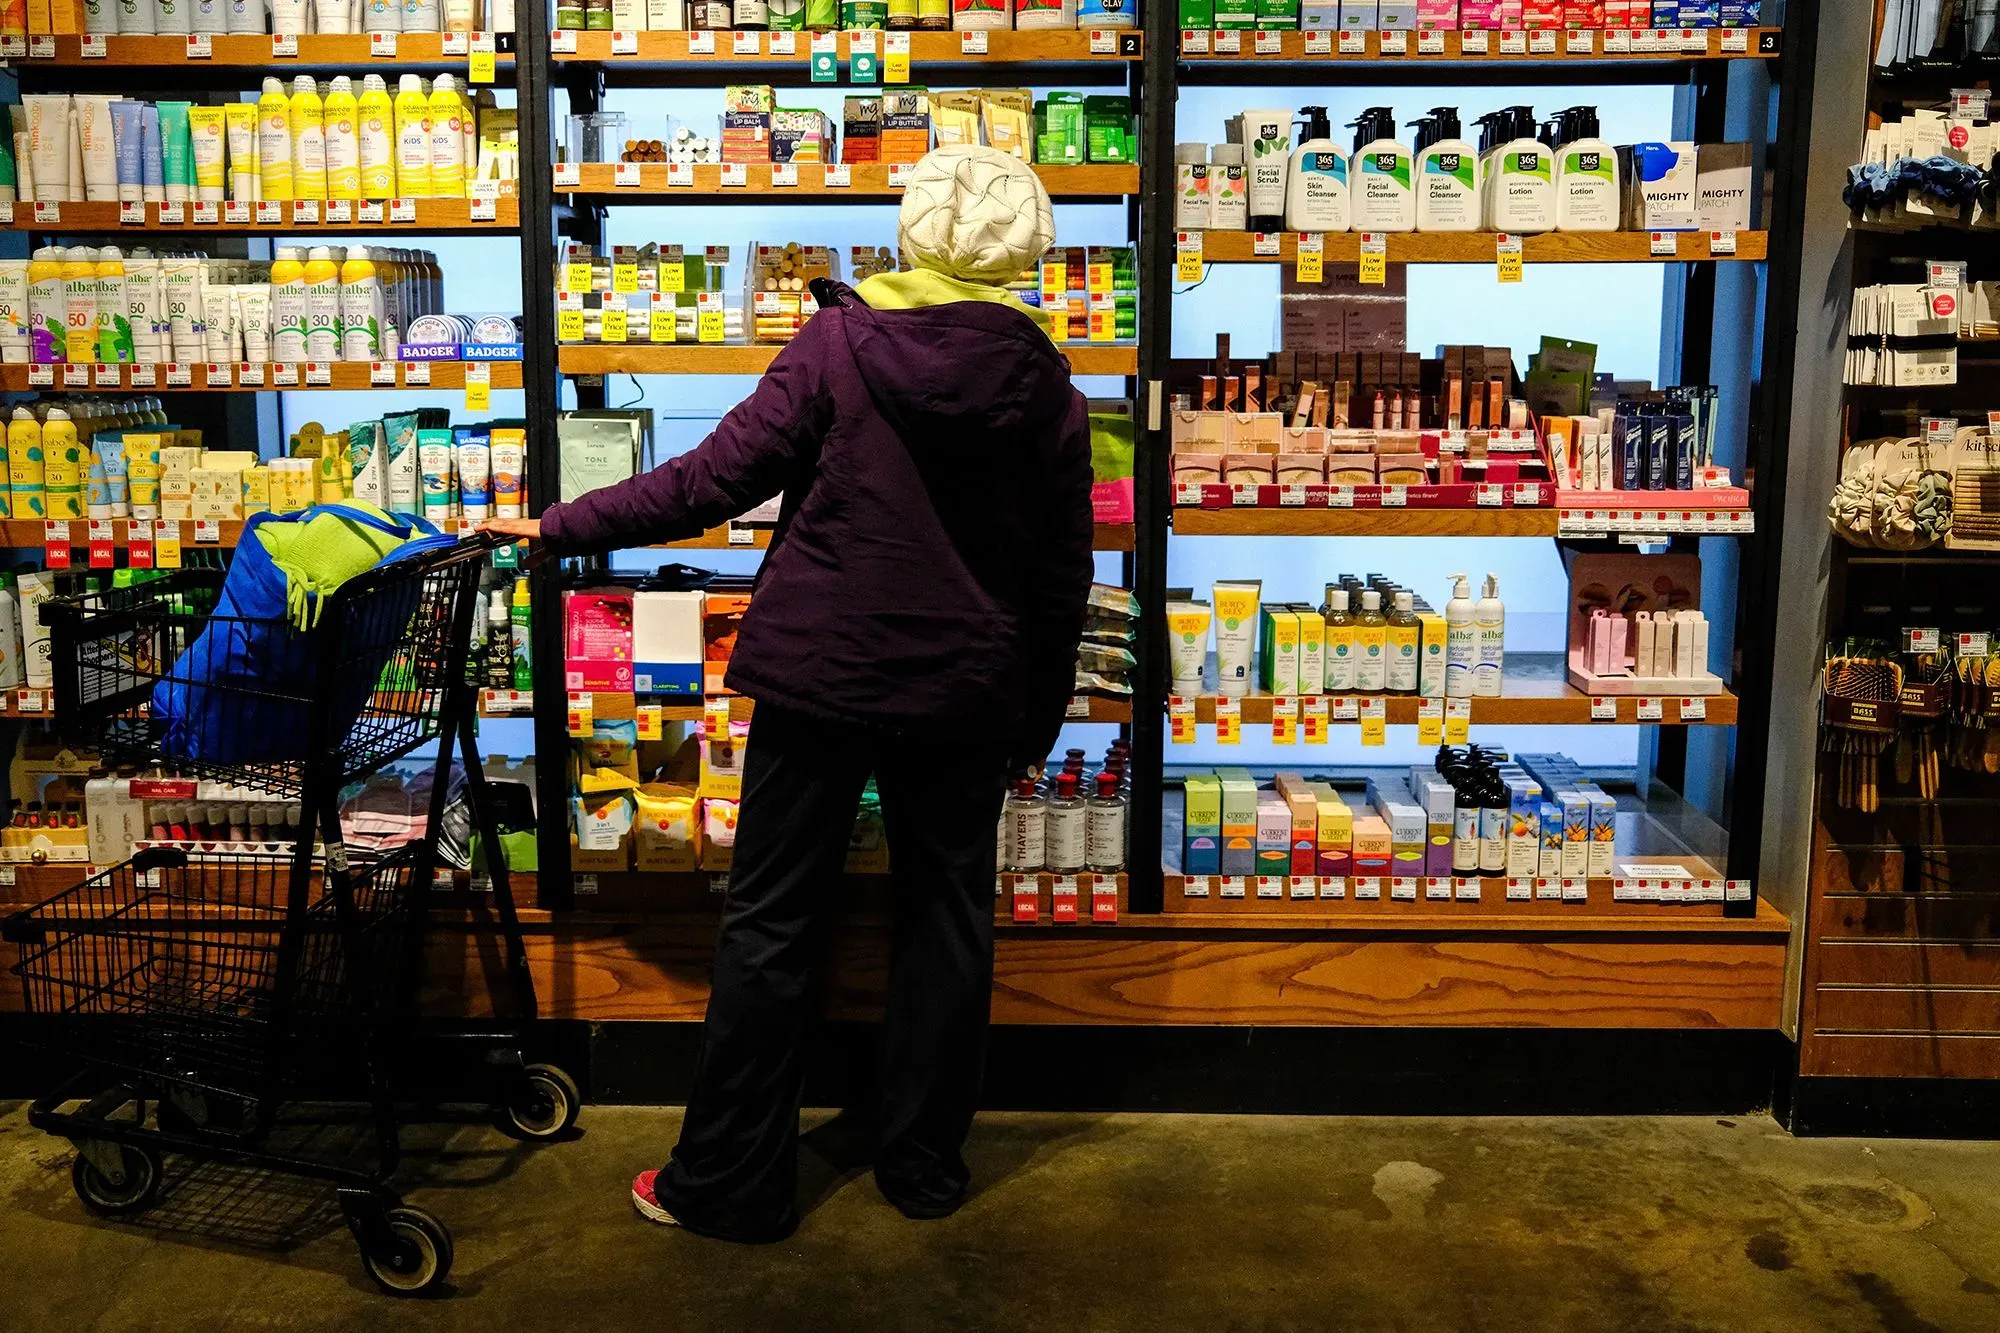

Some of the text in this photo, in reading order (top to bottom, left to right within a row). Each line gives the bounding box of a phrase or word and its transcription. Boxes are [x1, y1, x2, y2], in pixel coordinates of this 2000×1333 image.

[501, 37, 508, 48] 1
[1126, 40, 1135, 51] 2
[1263, 127, 1277, 135] 365
[1317, 155, 1334, 164] 365
[1378, 155, 1395, 165] 365
[1441, 155, 1458, 165] 365
[1519, 155, 1536, 165] 365
[1580, 155, 1597, 165] 365
[1193, 167, 1206, 175] 365
[1228, 167, 1241, 175] 365
[1257, 169, 1280, 177] Facial
[1257, 176, 1280, 184] Scrub
[500, 185, 513, 194] 20
[1509, 187, 1533, 195] Lotion
[1570, 187, 1594, 195] Lotion
[1701, 189, 1744, 198] MIGHTY
[1646, 192, 1689, 201] MIGHTY
[1646, 202, 1674, 211] PATCH
[1701, 199, 1729, 208] PATCH
[1180, 264, 1199, 272] Price
[1300, 264, 1320, 272] Price
[1500, 265, 1520, 273] Price
[128, 274, 151, 283] alba
[168, 274, 191, 283] alba
[570, 275, 589, 283] Price
[616, 275, 636, 283] Price
[662, 275, 682, 283] Price
[66, 282, 95, 293] alba
[279, 285, 303, 295] alba
[310, 285, 335, 295] alba
[345, 285, 370, 295] alba
[130, 302, 145, 314] 50
[171, 302, 186, 314] 30
[69, 313, 86, 327] 50
[208, 319, 218, 327] 50
[249, 319, 261, 328] 30
[281, 314, 298, 327] 50
[312, 314, 329, 327] 30
[347, 314, 364, 327] 30
[403, 347, 455, 358] BADGER
[466, 347, 517, 358] BADGER
[421, 437, 448, 445] BADGER
[459, 437, 488, 445] BADGER
[427, 457, 439, 465] 40
[467, 457, 479, 465] 40
[500, 456, 512, 465] 40
[585, 456, 609, 464] TONE
[402, 465, 413, 473] 30
[13, 472, 24, 480] 50
[50, 473, 63, 481] 30
[366, 482, 378, 491] 30
[286, 499, 297, 507] 30
[210, 504, 220, 512] 50
[94, 550, 111, 558] LOCAL
[1223, 608, 1242, 616] BEES
[1450, 631, 1471, 640] alba
[1481, 630, 1502, 640] alba
[1901, 693, 1921, 701] BASS
[1853, 707, 1873, 716] BASS
[1017, 813, 1027, 861] THAYERS
[1018, 904, 1035, 912] LOCAL
[1096, 904, 1113, 912] LOCAL
